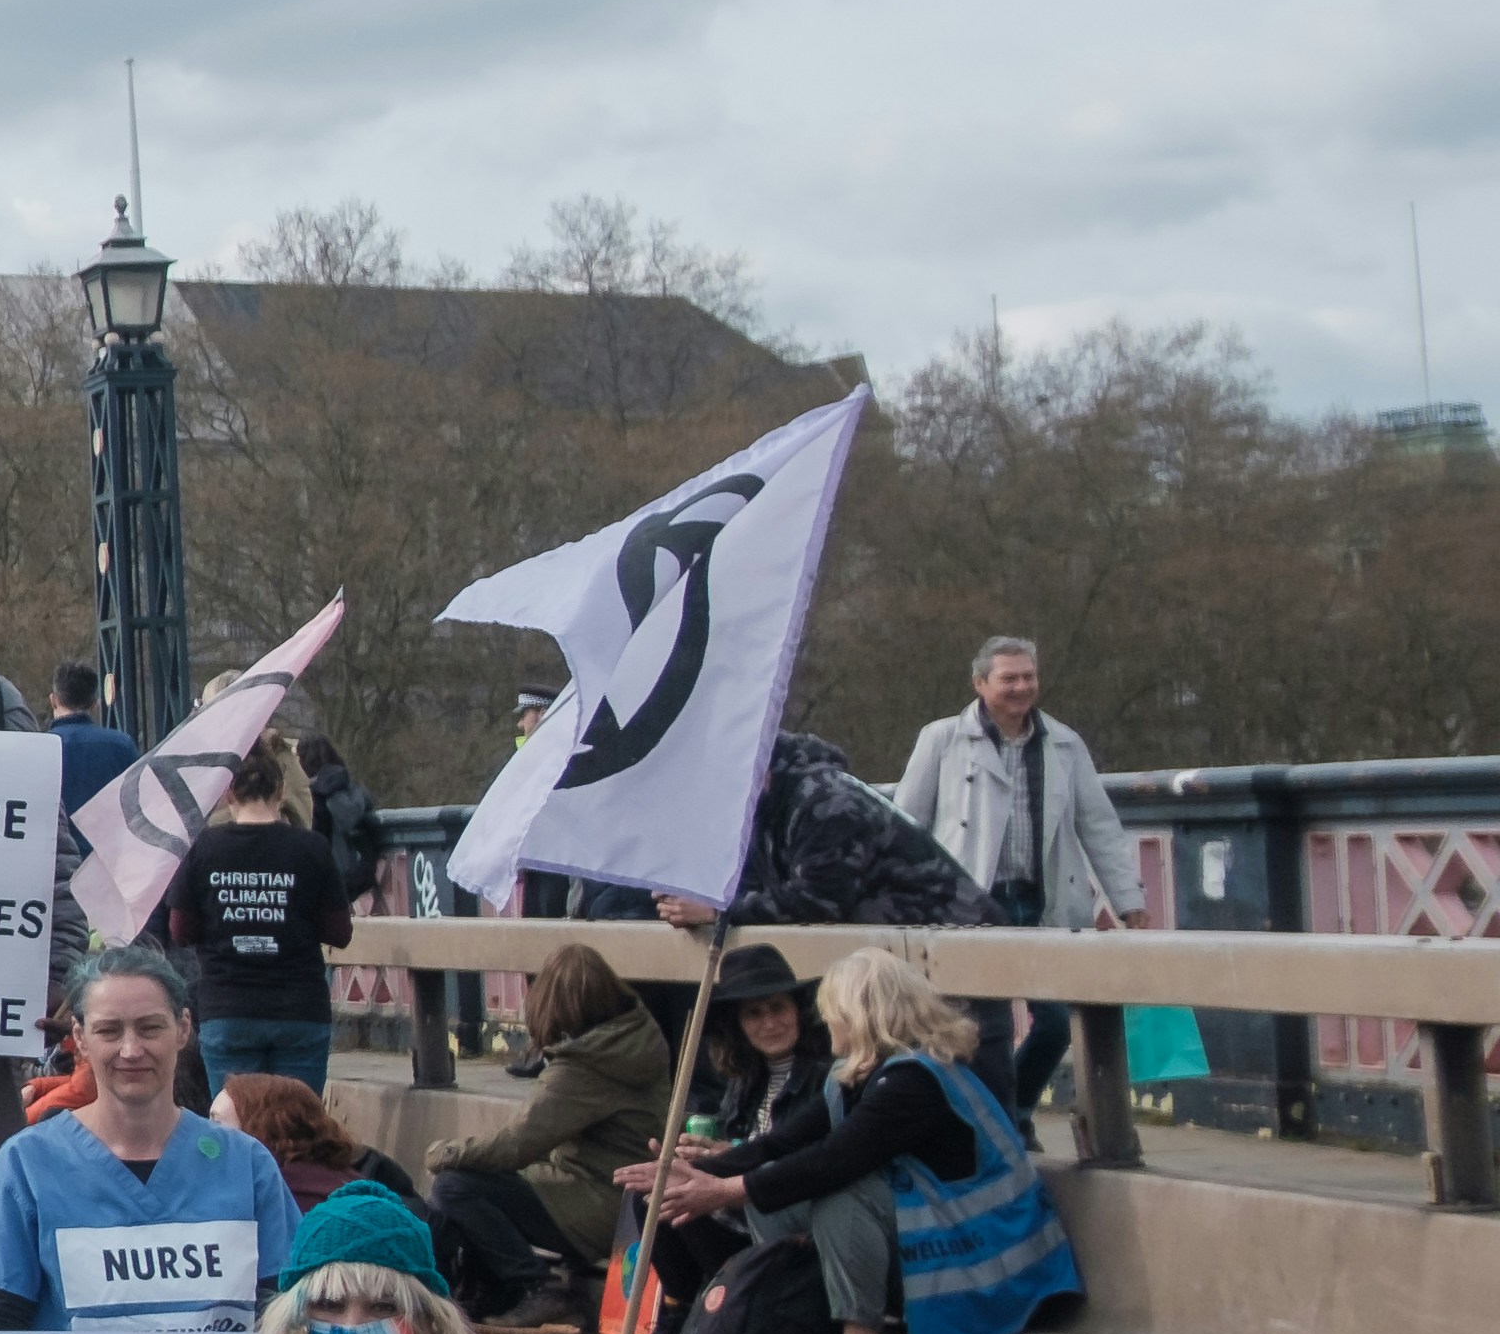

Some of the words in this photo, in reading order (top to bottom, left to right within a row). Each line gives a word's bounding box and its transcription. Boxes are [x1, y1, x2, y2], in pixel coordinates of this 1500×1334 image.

[210, 872, 295, 887] CHRISTIAN
[218, 889, 288, 904] CLIMATE
[223, 907, 285, 922] ACTION
[102, 1243, 222, 1282] NURSE
